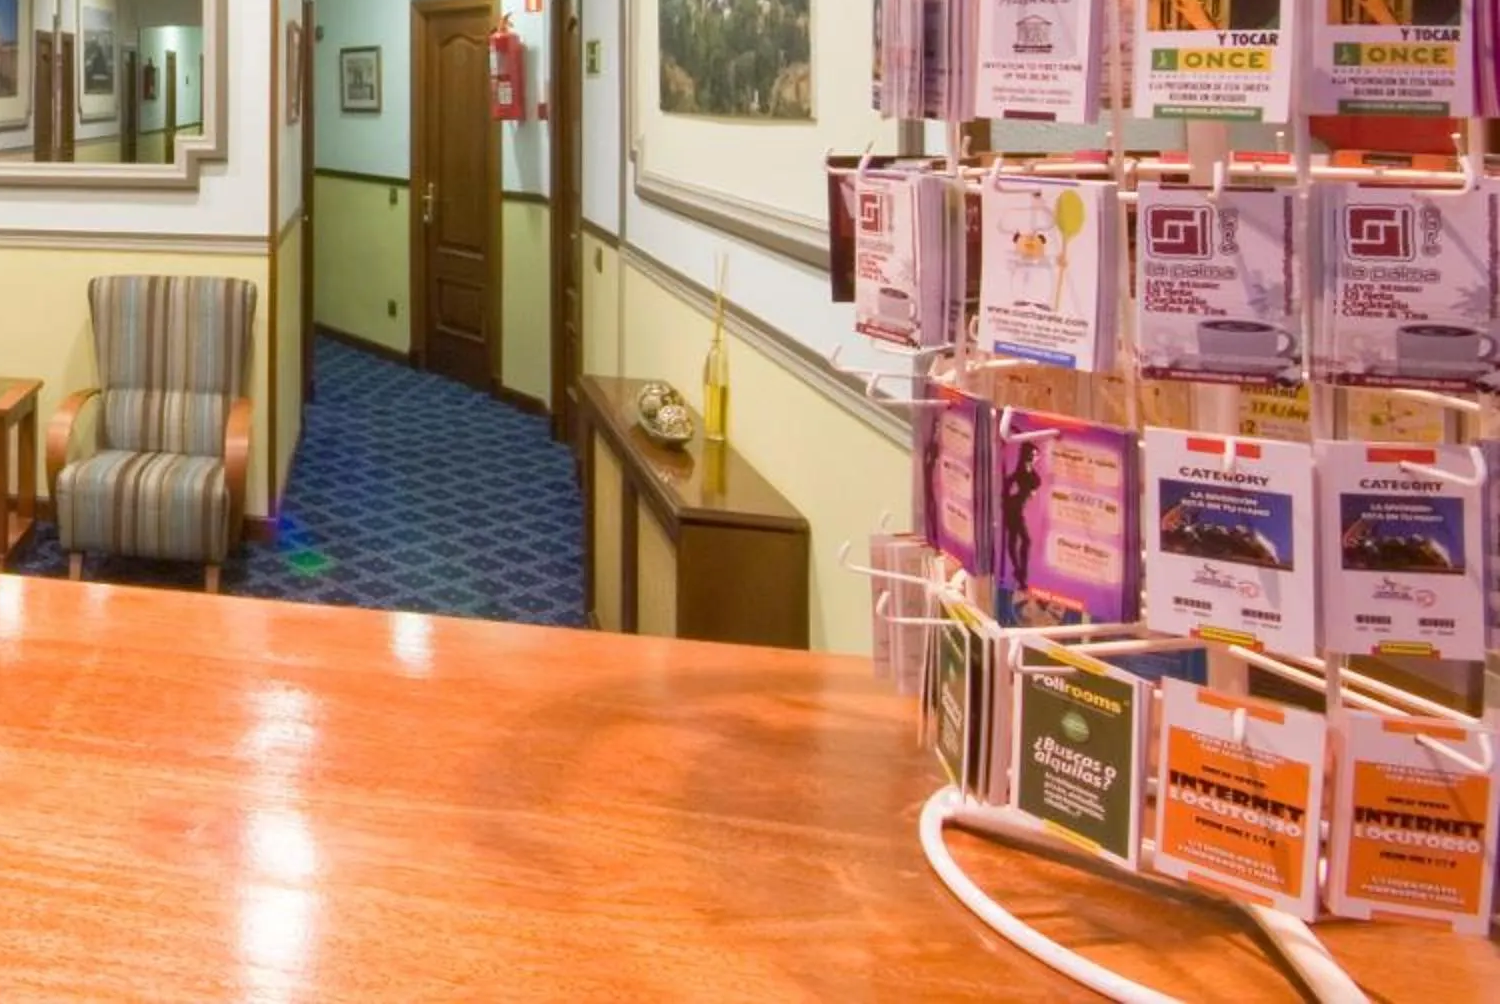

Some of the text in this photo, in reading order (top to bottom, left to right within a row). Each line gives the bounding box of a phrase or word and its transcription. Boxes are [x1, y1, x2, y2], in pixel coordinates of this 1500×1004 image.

[1218, 33, 1279, 46] Y TOCAR
[1400, 28, 1461, 41] Y TOCAR
[1183, 51, 1265, 69] ONCE
[1367, 47, 1449, 64] ONCE
[1179, 466, 1270, 487] CATEGORY
[1359, 478, 1444, 492] CATEGORY
[1033, 749, 1114, 791] alquilas?
[1034, 735, 1117, 780] ¿Buscas o
[1168, 768, 1305, 824] INTERNET
[1169, 785, 1301, 838] LOCUTORIO
[1353, 805, 1485, 839] INTERNET
[1353, 824, 1481, 854] LOCUTORIO
